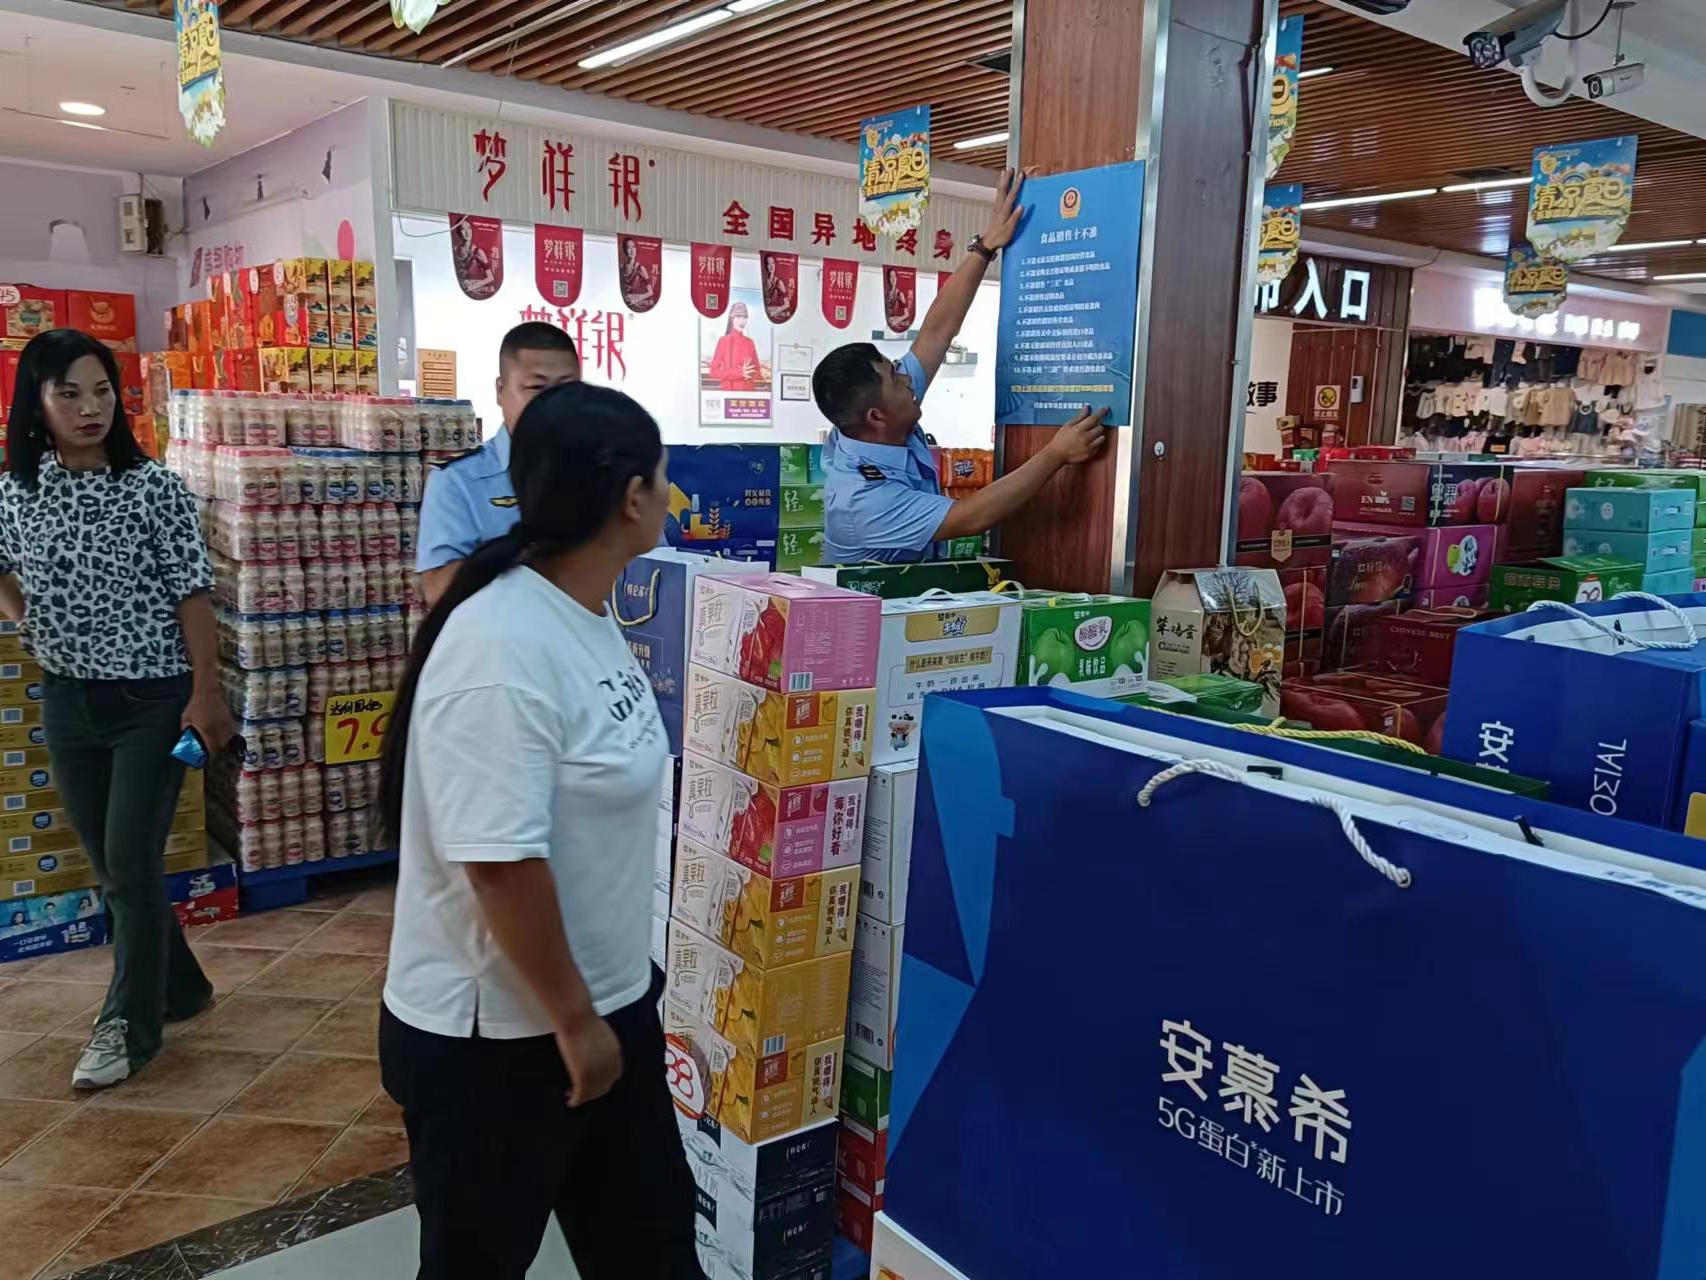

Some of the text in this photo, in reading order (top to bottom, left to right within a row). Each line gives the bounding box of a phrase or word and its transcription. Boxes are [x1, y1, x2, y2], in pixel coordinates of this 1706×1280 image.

[474, 128, 642, 223] 梦祥银
[866, 149, 927, 192] 清凉夏日
[1534, 177, 1627, 216] 清凉夏日
[1159, 1018, 1353, 1164] 安慕希
